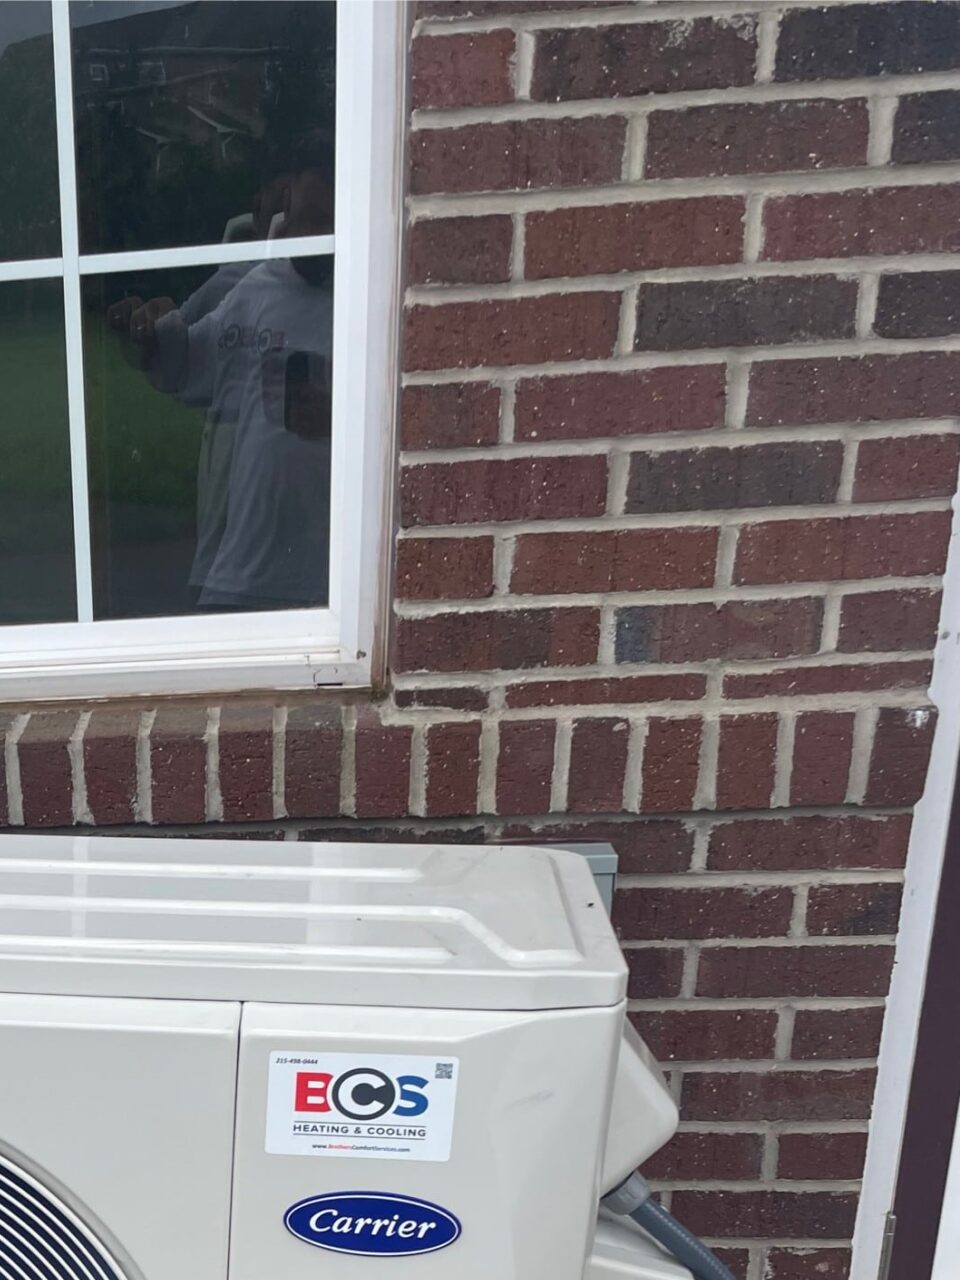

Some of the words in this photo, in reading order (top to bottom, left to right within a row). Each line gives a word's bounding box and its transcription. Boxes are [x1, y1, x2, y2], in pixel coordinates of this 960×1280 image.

[294, 1067, 429, 1121] BCS
[293, 1124, 349, 1134] HEATING
[354, 1126, 362, 1135] &
[367, 1127, 427, 1137] COOLING
[309, 1209, 437, 1238] Carrier
